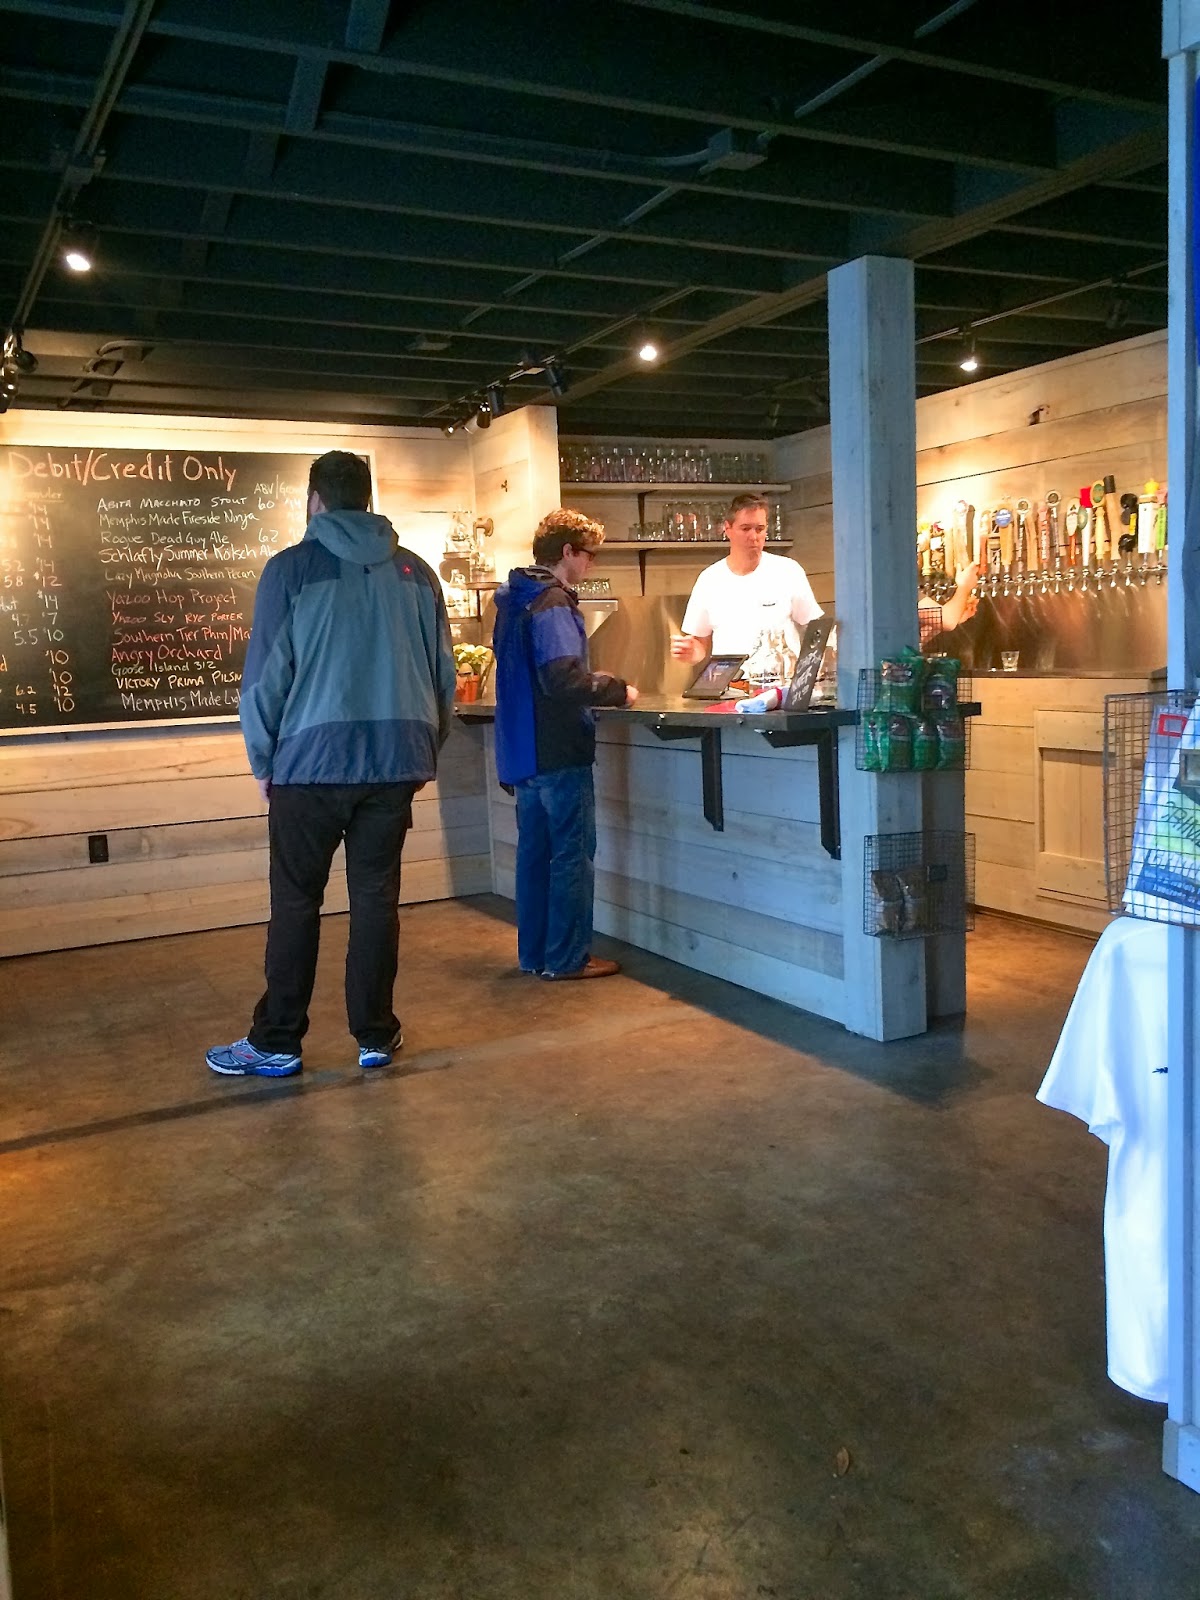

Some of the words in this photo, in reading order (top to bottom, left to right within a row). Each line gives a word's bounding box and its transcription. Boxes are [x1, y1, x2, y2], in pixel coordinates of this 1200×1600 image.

[8, 450, 173, 486] Debit/Credit
[183, 455, 237, 492] Only
[97, 498, 132, 513] ABITA
[211, 497, 248, 508] STOUT
[99, 513, 147, 531] Memphis
[149, 513, 180, 526] Made
[181, 511, 220, 525] Fireside
[223, 509, 260, 530] Ninja
[101, 531, 144, 549] Rogue
[151, 531, 182, 545] Dead
[185, 532, 206, 549] Guy
[209, 531, 230, 544] Ale
[99, 546, 163, 571] Schlafly
[164, 545, 209, 562] Summer
[105, 570, 133, 589] Lazy
[184, 567, 225, 581] Southern
[225, 567, 256, 579] Pecan
[106, 589, 151, 611] Yazoo
[156, 588, 185, 609] Hop
[189, 587, 238, 612] Project
[154, 612, 175, 623] SLY
[211, 612, 243, 622] PORTER
[111, 627, 175, 645] Southern
[176, 626, 200, 641] Tier
[111, 647, 153, 672] Angry
[157, 644, 223, 661] Orchard
[111, 662, 144, 676] Goose
[154, 661, 190, 673] Island
[194, 660, 217, 671] 312
[115, 677, 161, 690] VICTORY
[167, 674, 205, 690] PRIMA
[189, 689, 221, 707] Made
